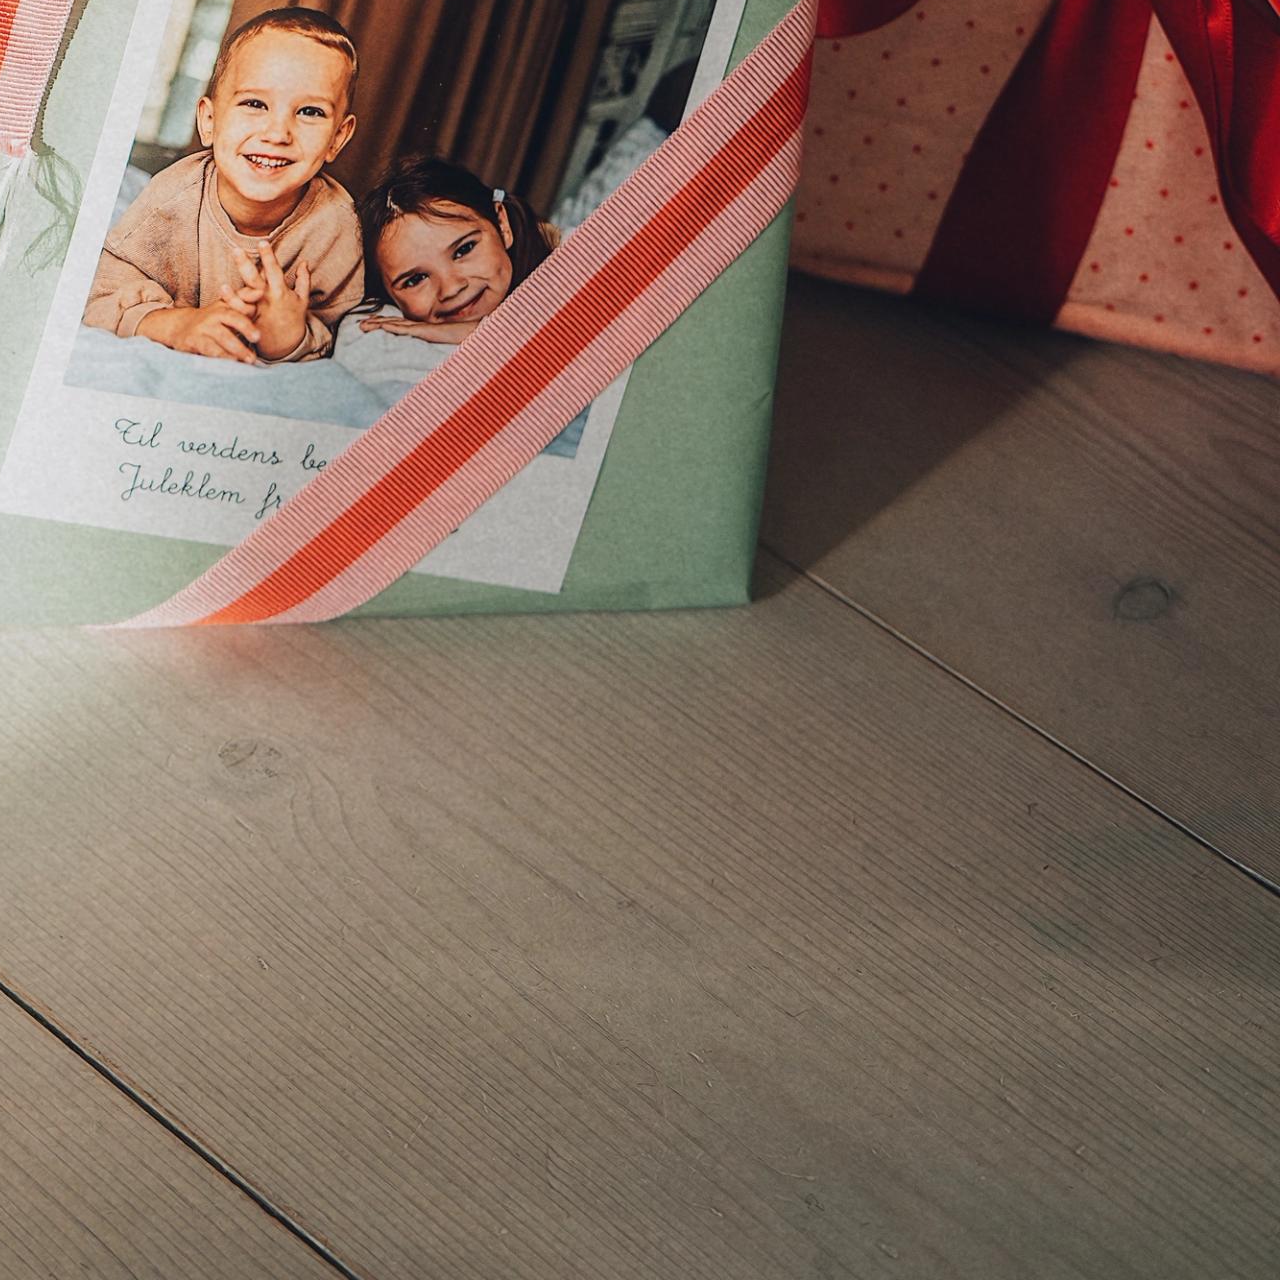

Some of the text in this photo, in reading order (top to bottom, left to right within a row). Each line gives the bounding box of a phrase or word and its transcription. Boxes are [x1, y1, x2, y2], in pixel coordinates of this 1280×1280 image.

[114, 418, 162, 448] Til
[177, 437, 283, 465] verdens
[119, 462, 282, 520] Juleklem fr
